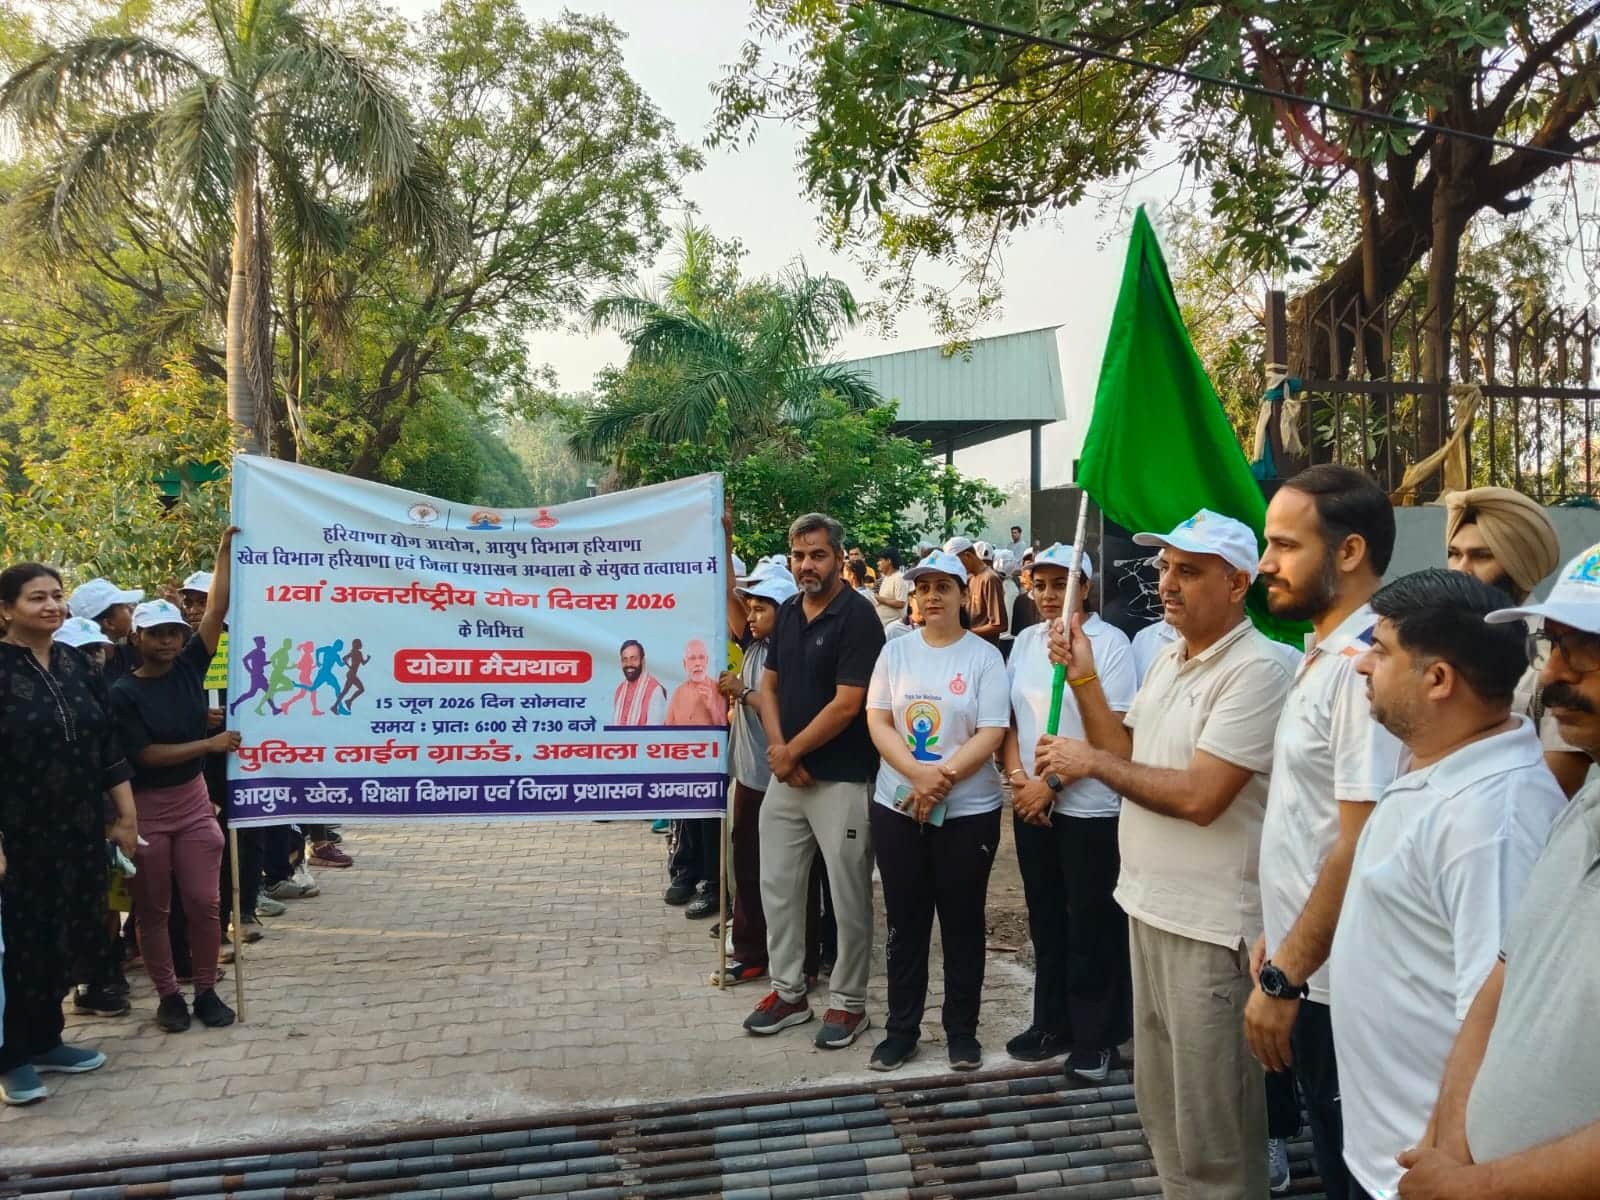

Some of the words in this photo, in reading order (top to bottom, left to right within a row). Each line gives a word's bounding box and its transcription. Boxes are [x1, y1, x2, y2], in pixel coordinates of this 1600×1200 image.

[323, 523, 385, 545] हरियाणा
[390, 532, 420, 549] योग
[424, 536, 480, 554] आयोग,
[486, 539, 527, 559] आयुष
[531, 536, 579, 555] विभाग
[583, 536, 642, 556] हरियाणा
[237, 546, 267, 566] खेल
[272, 546, 324, 567] विभाग
[328, 549, 390, 570] हरियाणा
[395, 554, 415, 570] एवं
[419, 555, 457, 574] जिला
[462, 562, 517, 578] प्रशासन
[522, 563, 575, 578] अम्बाला
[579, 559, 593, 577] के
[596, 558, 640, 581] संयुक्त
[706, 556, 718, 574] में
[265, 579, 328, 602] 12वां
[330, 581, 476, 612] अन्तर्राष्ट्रीय
[485, 588, 540, 609] योग
[547, 587, 618, 610] दिवस
[625, 593, 676, 609] 2026
[458, 619, 473, 638] के
[476, 620, 524, 639] निमित्त
[405, 652, 473, 676] योगा
[479, 651, 580, 677] मैराथान
[375, 697, 393, 709] 15
[399, 696, 433, 714] जून
[439, 697, 475, 709] 2026
[481, 692, 515, 709] दिन
[520, 693, 587, 709] सोमवार
[370, 720, 415, 734] समय
[432, 719, 469, 735] प्रातः
[511, 716, 527, 732] से
[568, 715, 597, 732] बजे
[237, 740, 326, 772] पुलिस
[334, 738, 419, 764] लाईन
[532, 743, 639, 761] अम्बाला
[646, 741, 719, 760] शहर।
[233, 786, 297, 812] आयुष,
[303, 781, 353, 805] खेल,
[361, 779, 411, 804] शिक्षा
[415, 779, 478, 803] विभाग
[483, 779, 511, 802] एवं
[517, 777, 567, 802] जिला
[573, 782, 642, 804] प्रशासन
[647, 781, 724, 800] अम्बाला।
